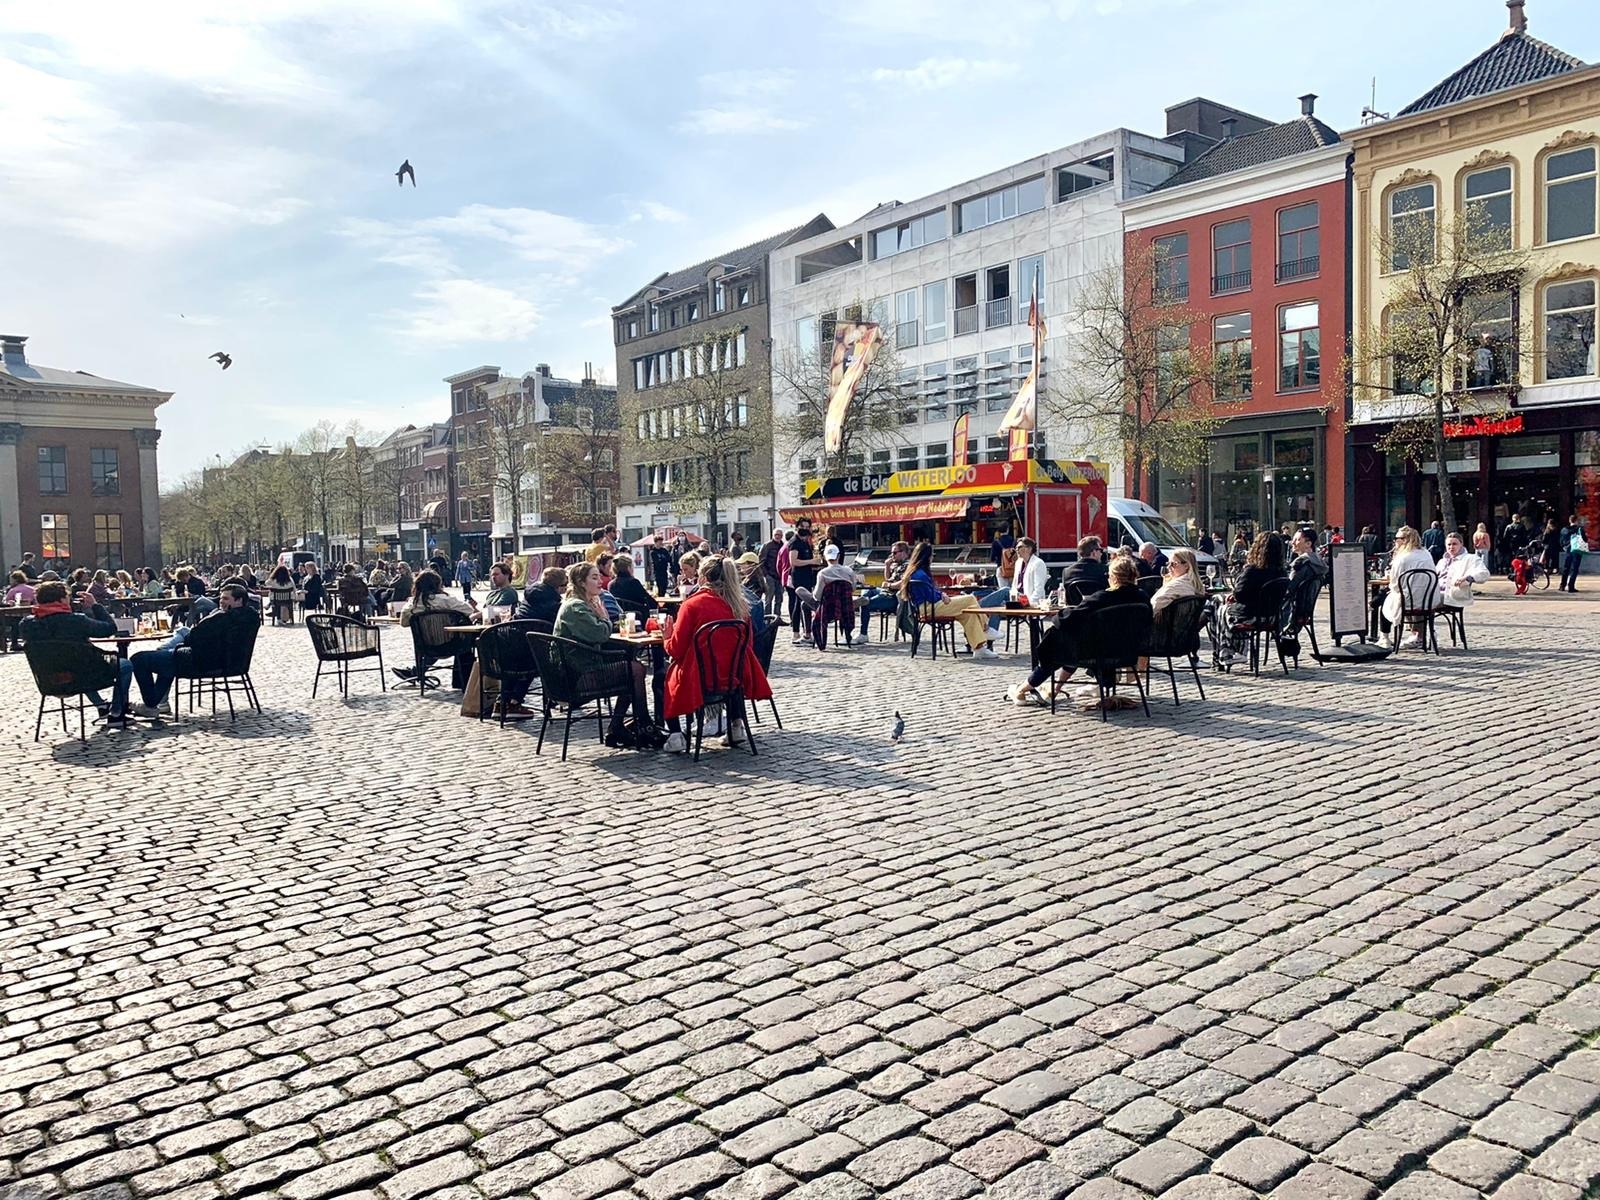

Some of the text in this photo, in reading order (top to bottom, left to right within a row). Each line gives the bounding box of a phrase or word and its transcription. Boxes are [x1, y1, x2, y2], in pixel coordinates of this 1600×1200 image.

[844, 467, 977, 493] de Belg WATERLOO
[1066, 466, 1106, 481] WATERLOO
